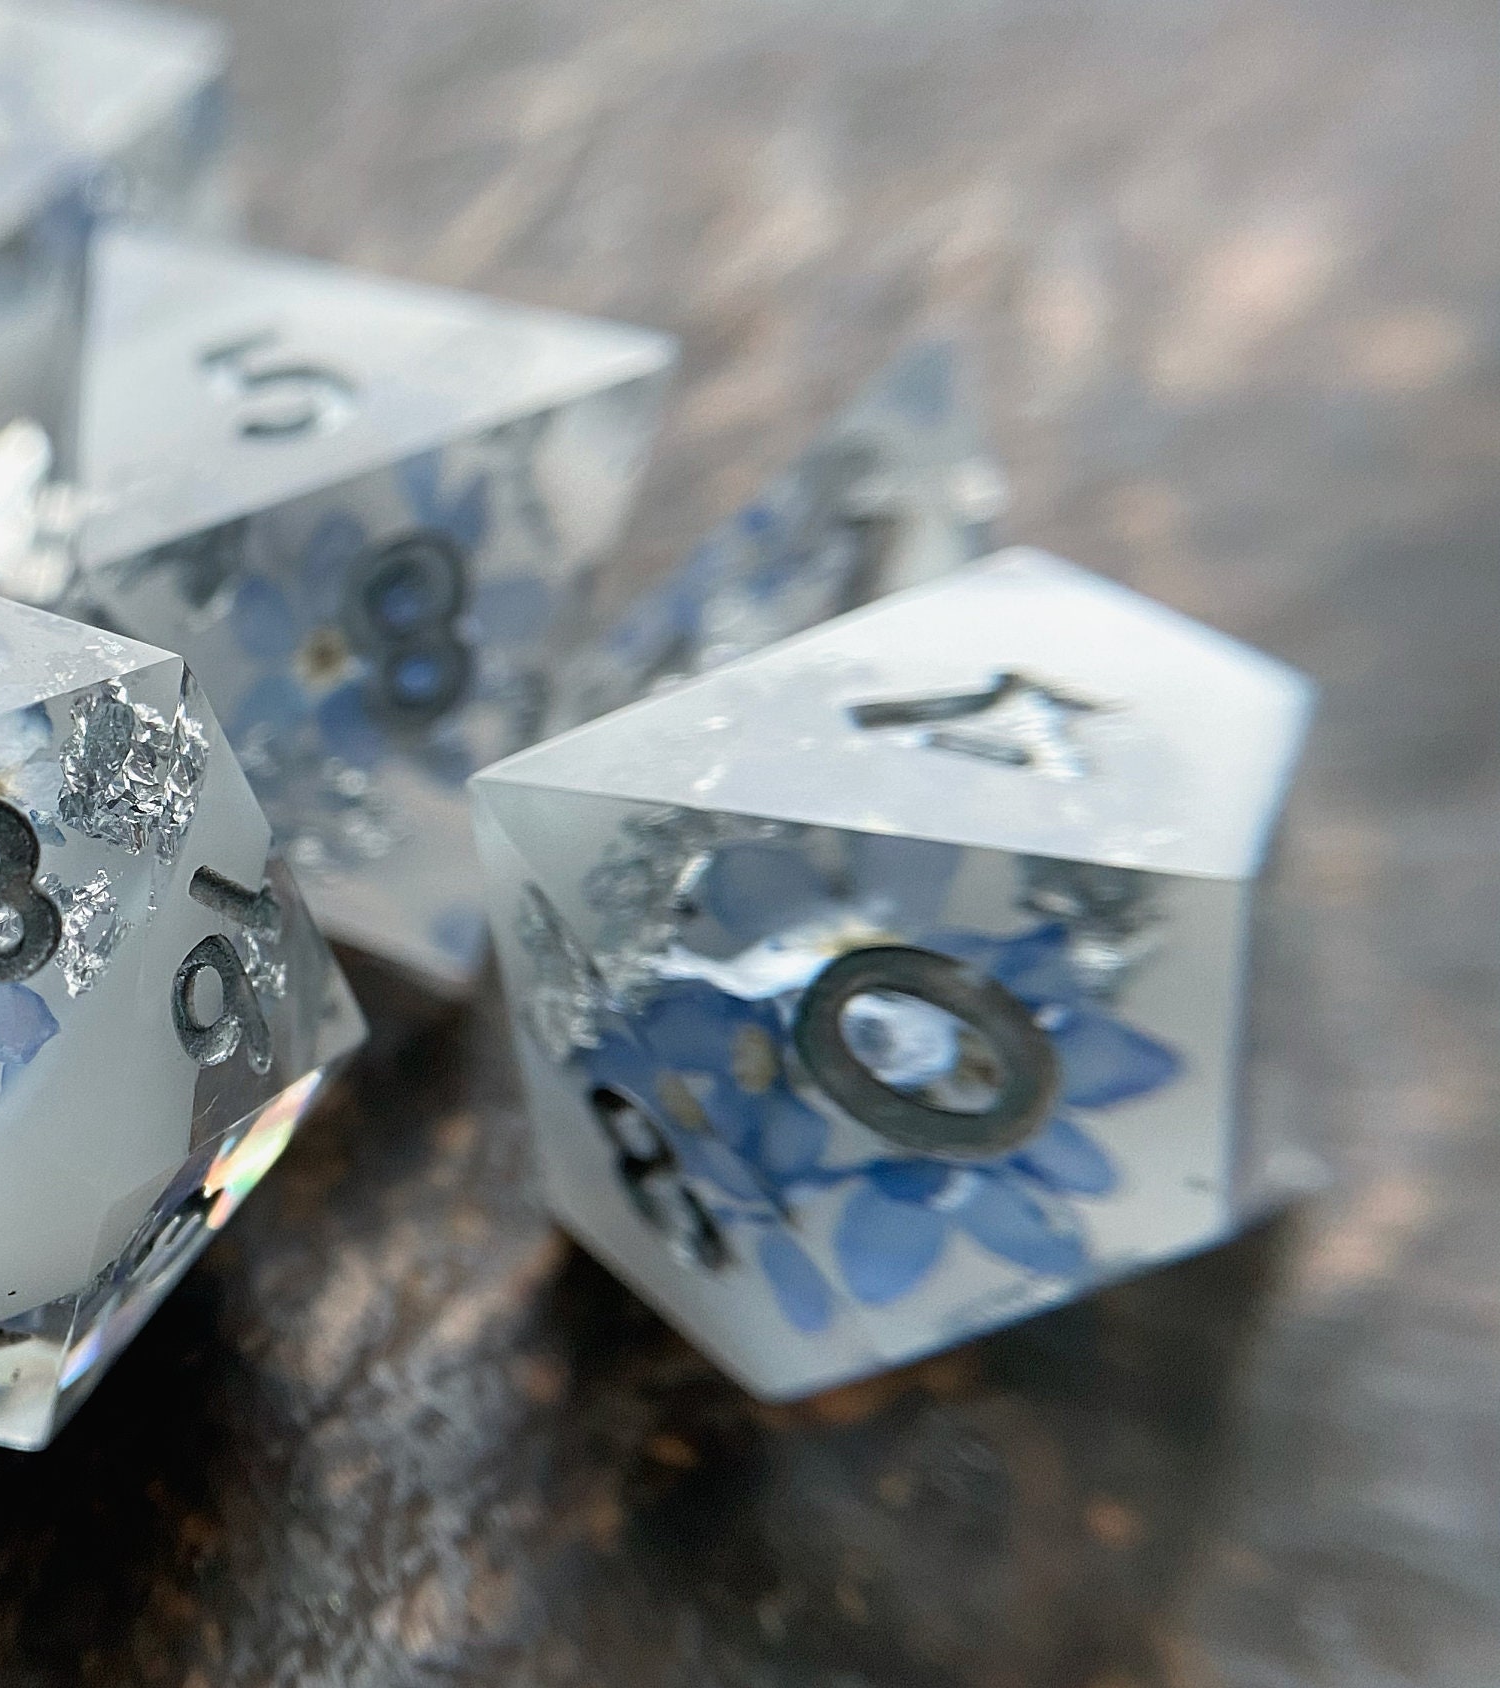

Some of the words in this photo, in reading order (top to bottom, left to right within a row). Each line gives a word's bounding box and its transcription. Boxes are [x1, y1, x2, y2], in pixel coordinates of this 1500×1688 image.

[196, 325, 360, 448] 5
[350, 528, 478, 735] 8
[792, 944, 1063, 1162] 0
